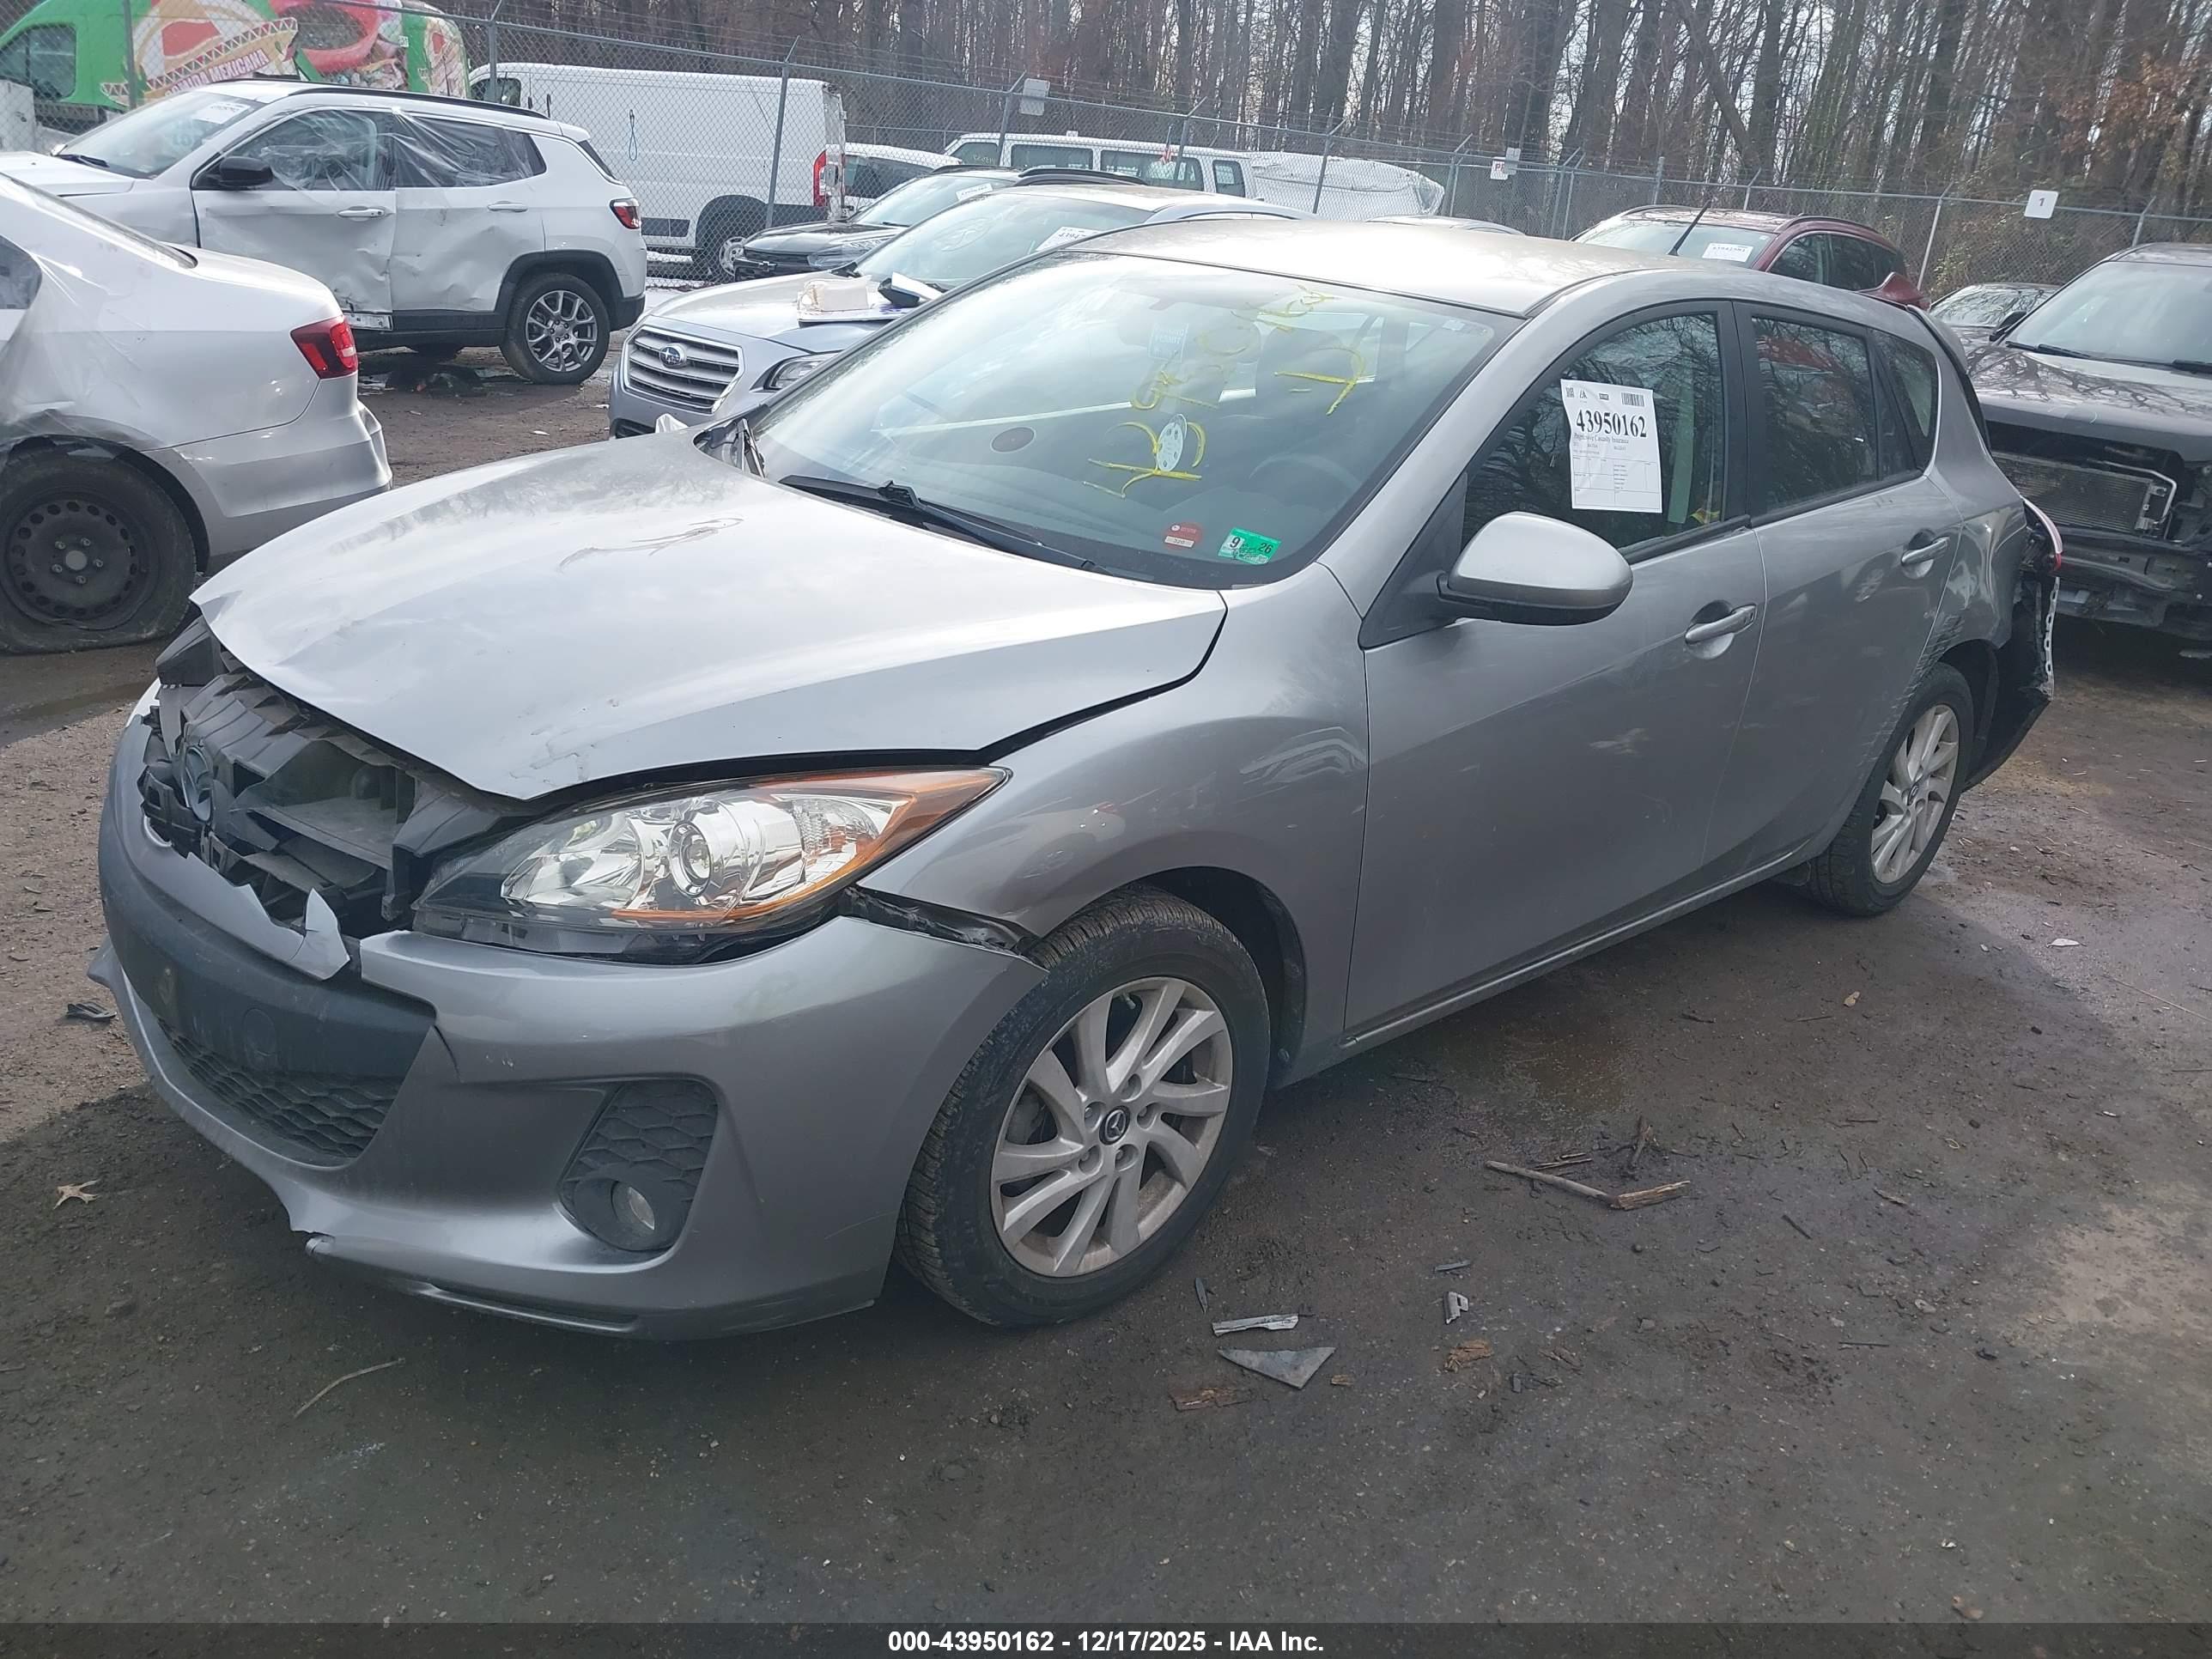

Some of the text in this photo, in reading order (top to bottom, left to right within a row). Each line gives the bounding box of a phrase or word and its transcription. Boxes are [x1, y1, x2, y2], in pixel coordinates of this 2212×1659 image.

[208, 48, 270, 83] MEXICANA
[2039, 198, 2046, 207] 1
[1576, 409, 1647, 438] 43950162
[1230, 537, 1241, 549] 9
[1257, 542, 1274, 555] 26
